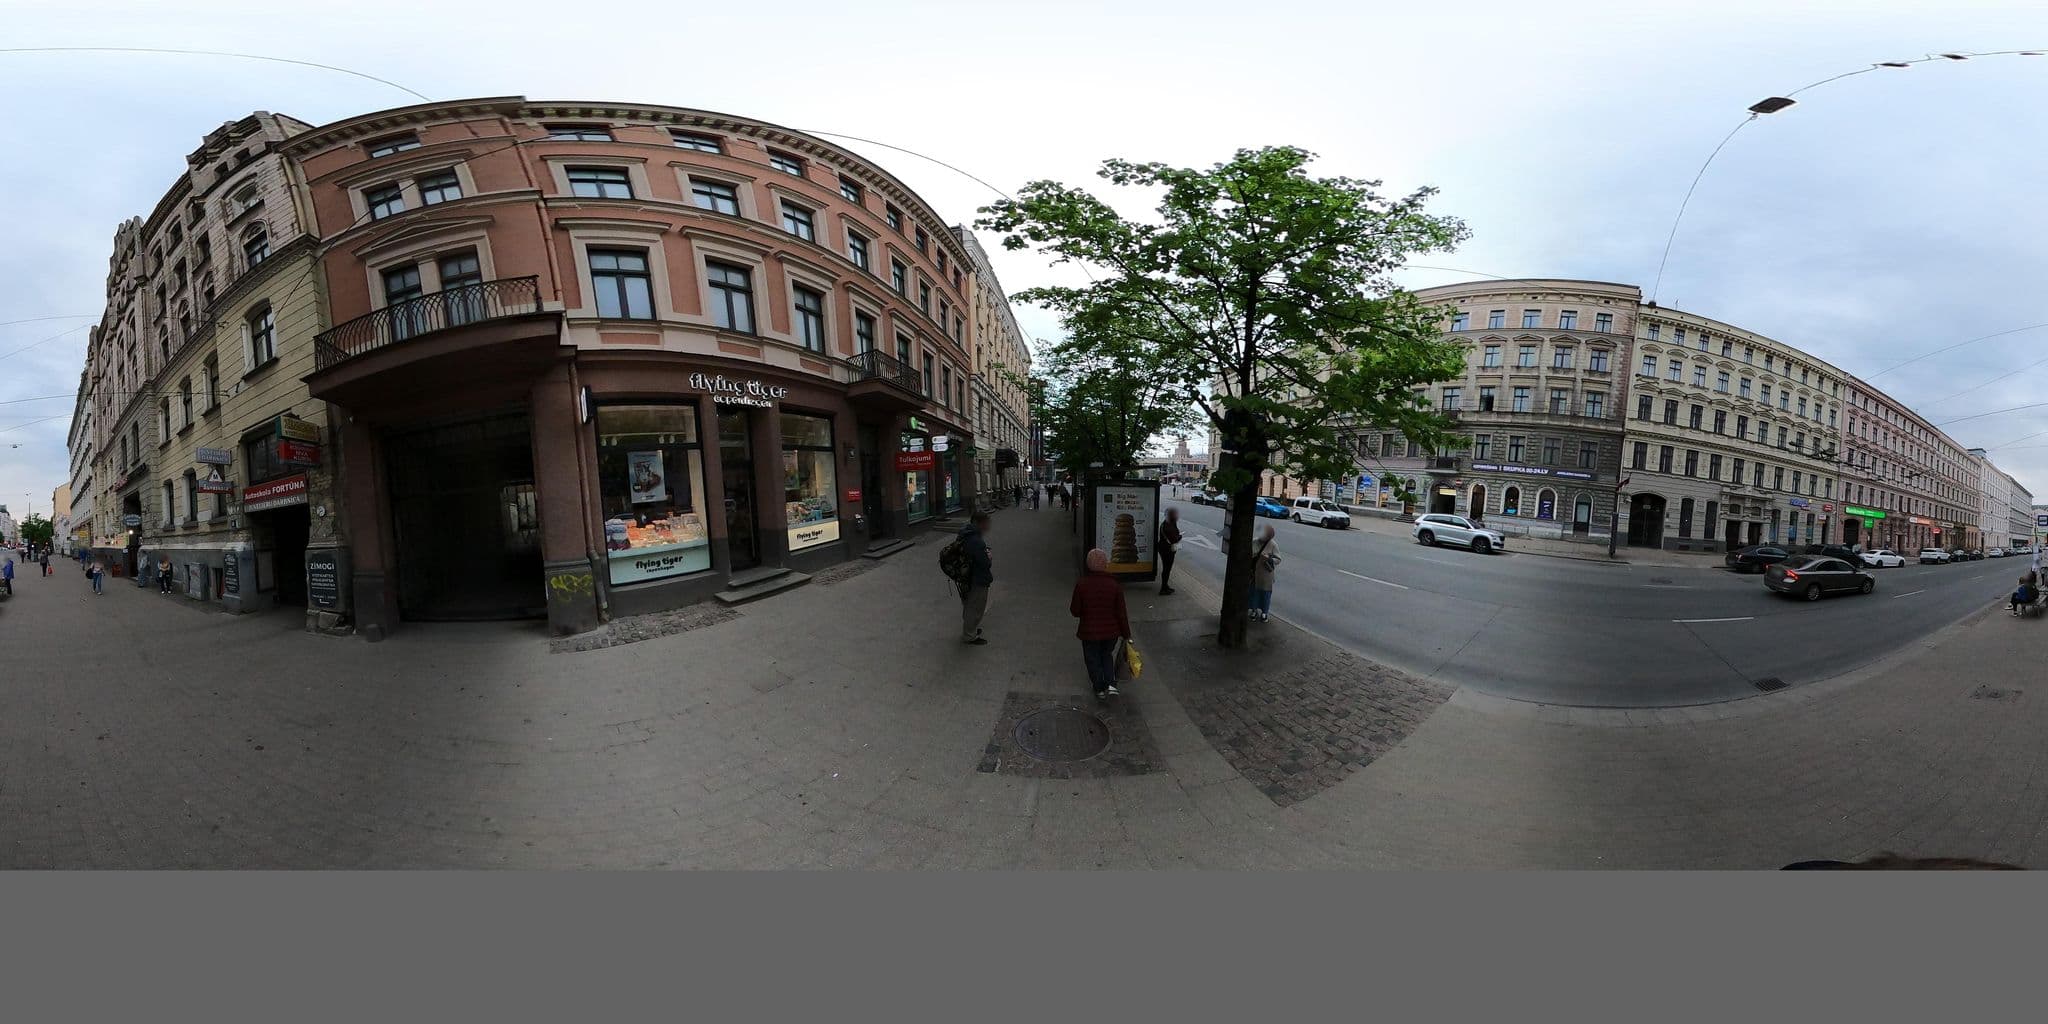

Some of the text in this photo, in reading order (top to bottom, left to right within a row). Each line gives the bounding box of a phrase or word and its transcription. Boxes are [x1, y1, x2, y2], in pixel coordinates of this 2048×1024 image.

[689, 372, 787, 400] flying tiger
[635, 555, 683, 569] flying tiger
